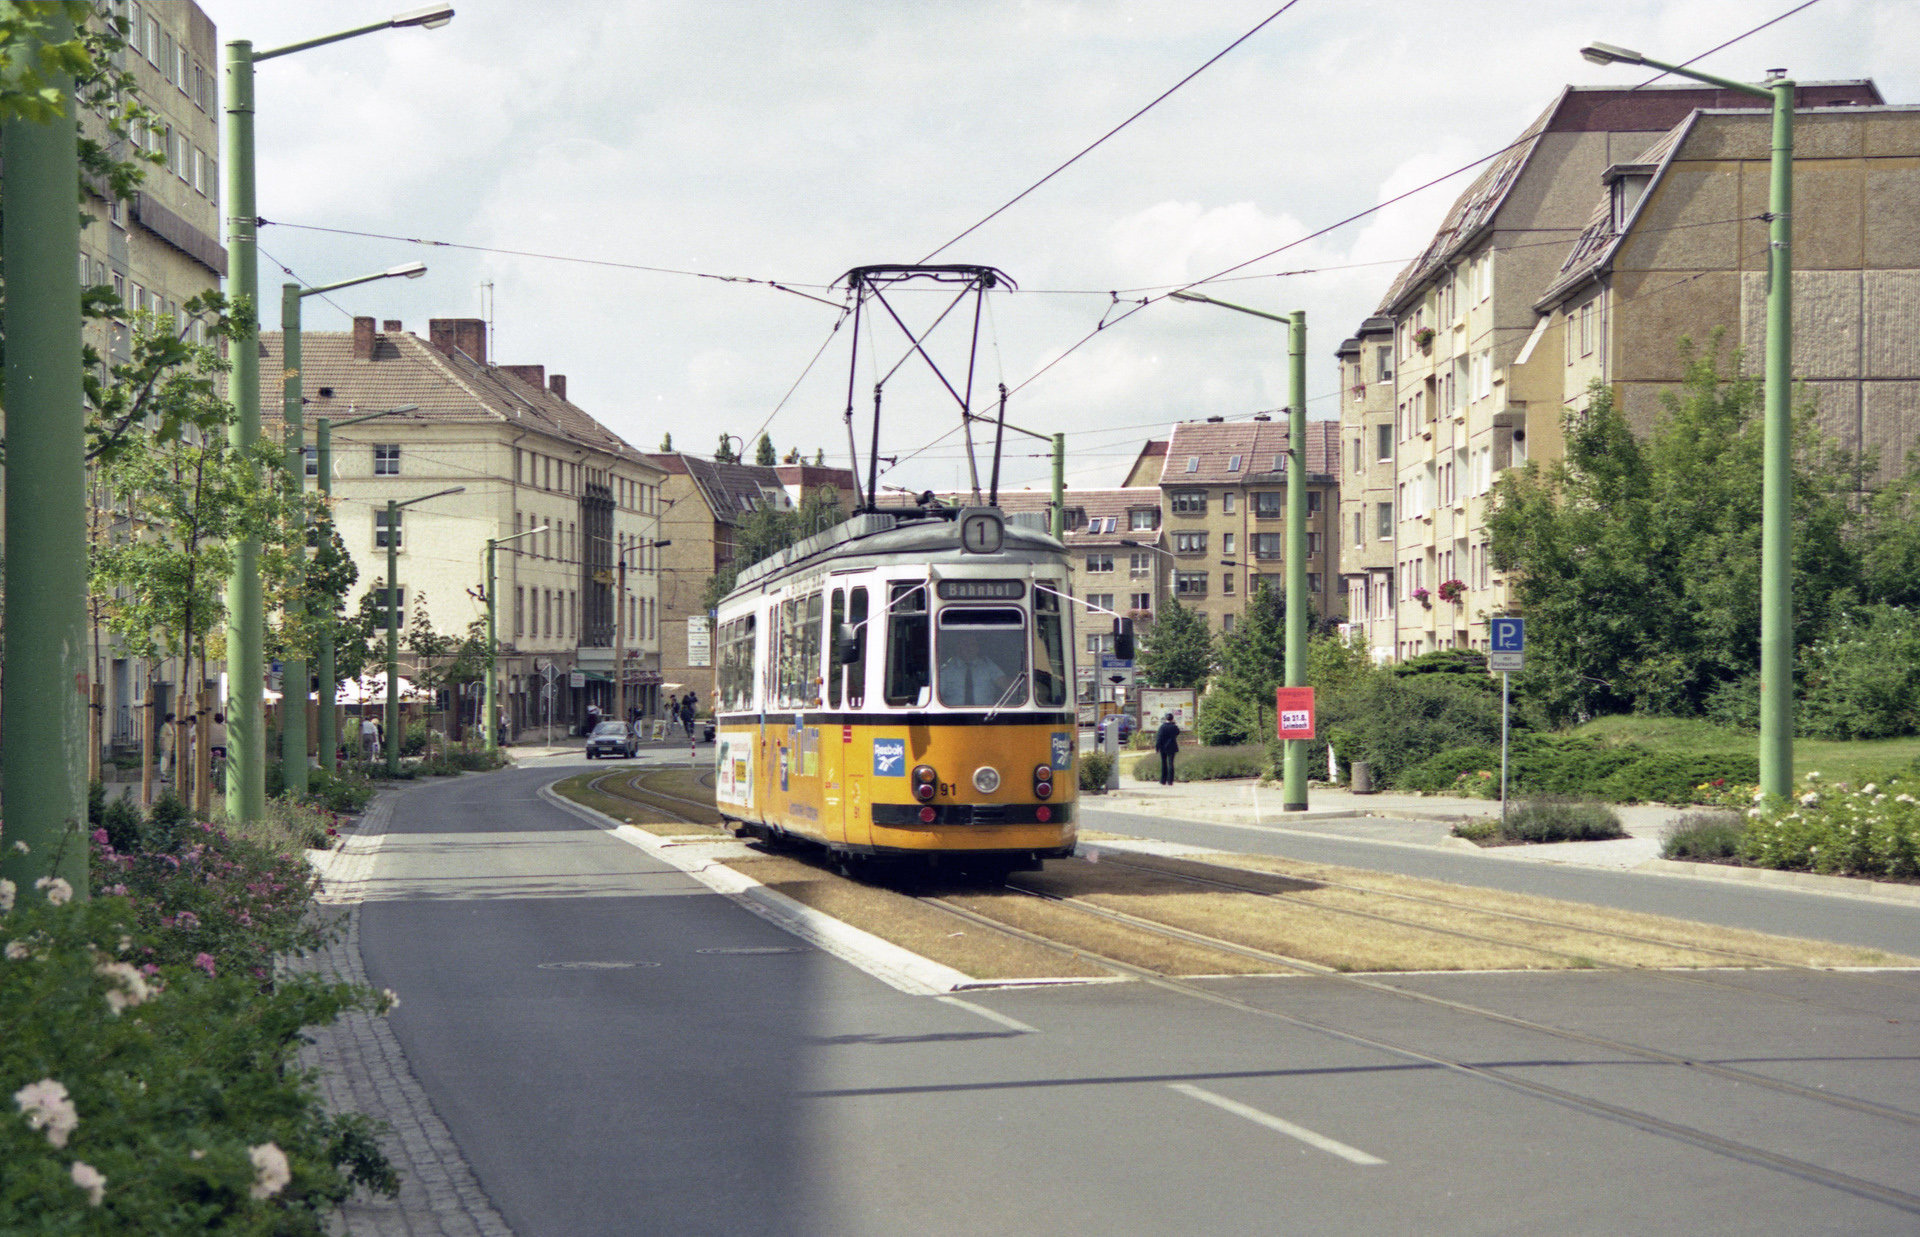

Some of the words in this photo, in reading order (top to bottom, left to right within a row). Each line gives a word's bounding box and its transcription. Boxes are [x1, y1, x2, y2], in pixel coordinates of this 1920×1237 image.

[976, 521, 985, 546] 1
[1499, 622, 1516, 647] P
[940, 783, 957, 796] 91
